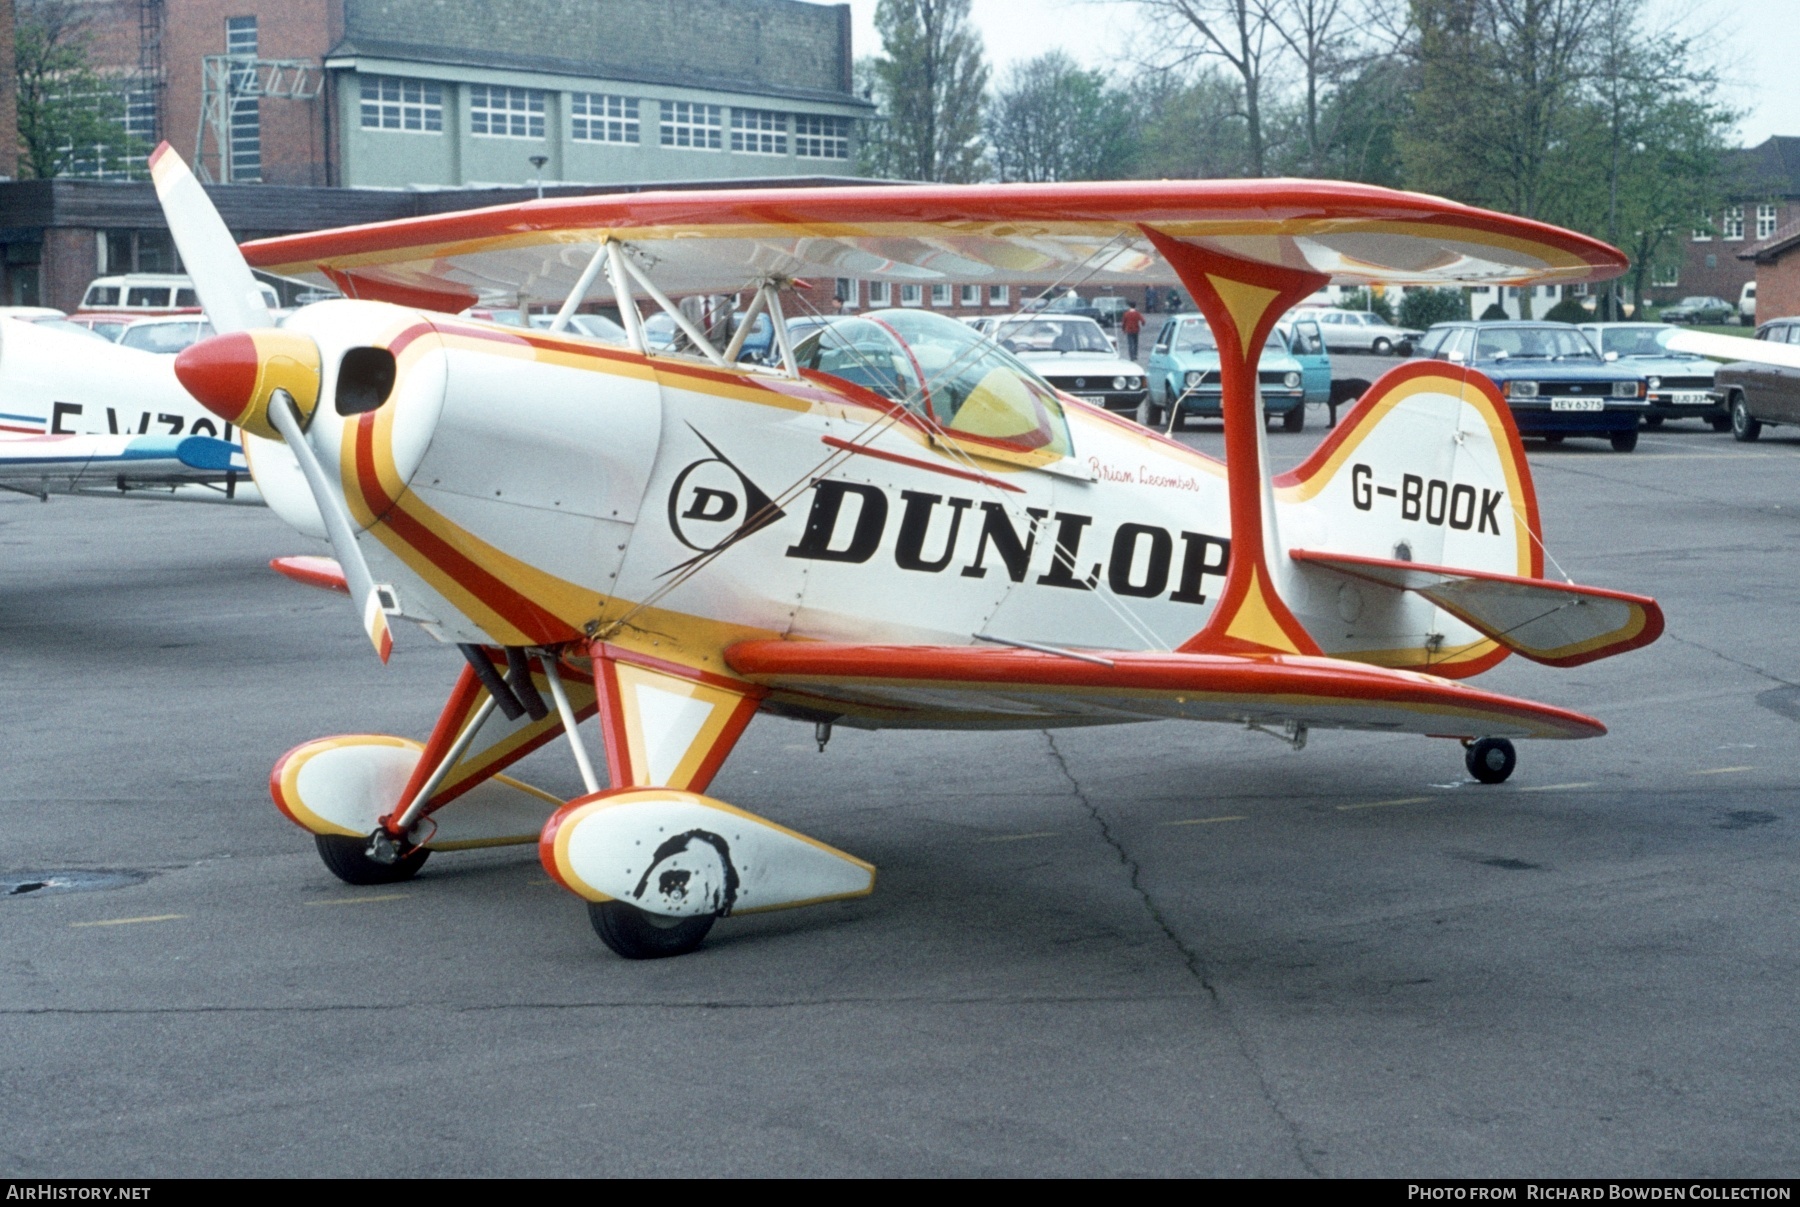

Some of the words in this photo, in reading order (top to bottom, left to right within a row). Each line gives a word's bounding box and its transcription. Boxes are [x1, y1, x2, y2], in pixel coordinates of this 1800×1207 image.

[1088, 456, 1134, 483] Brian
[681, 486, 738, 522] D
[1352, 463, 1504, 536] G-BOOK
[785, 477, 1232, 605] DUNLOP
